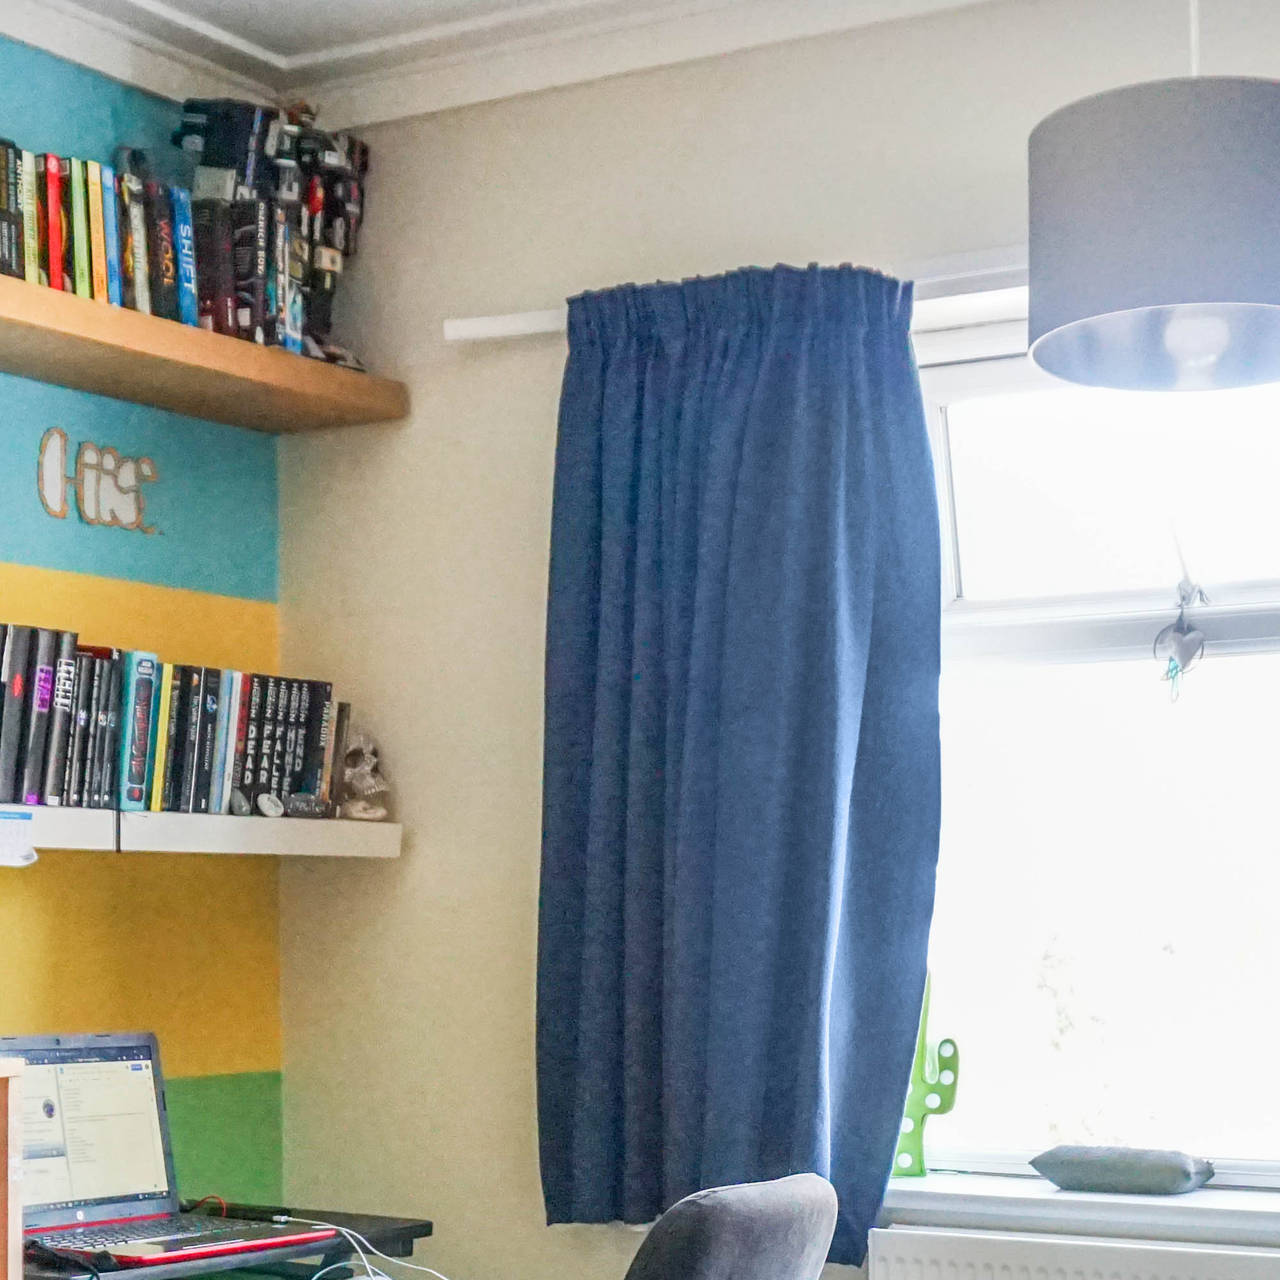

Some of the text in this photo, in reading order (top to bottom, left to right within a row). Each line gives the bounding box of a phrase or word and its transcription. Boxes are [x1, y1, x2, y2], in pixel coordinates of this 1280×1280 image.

[158, 219, 174, 287] WOOL
[180, 223, 196, 294] SHIFT
[319, 700, 330, 747] PARADOX
[244, 725, 257, 785] DEAD
[259, 724, 273, 784] FEAR
